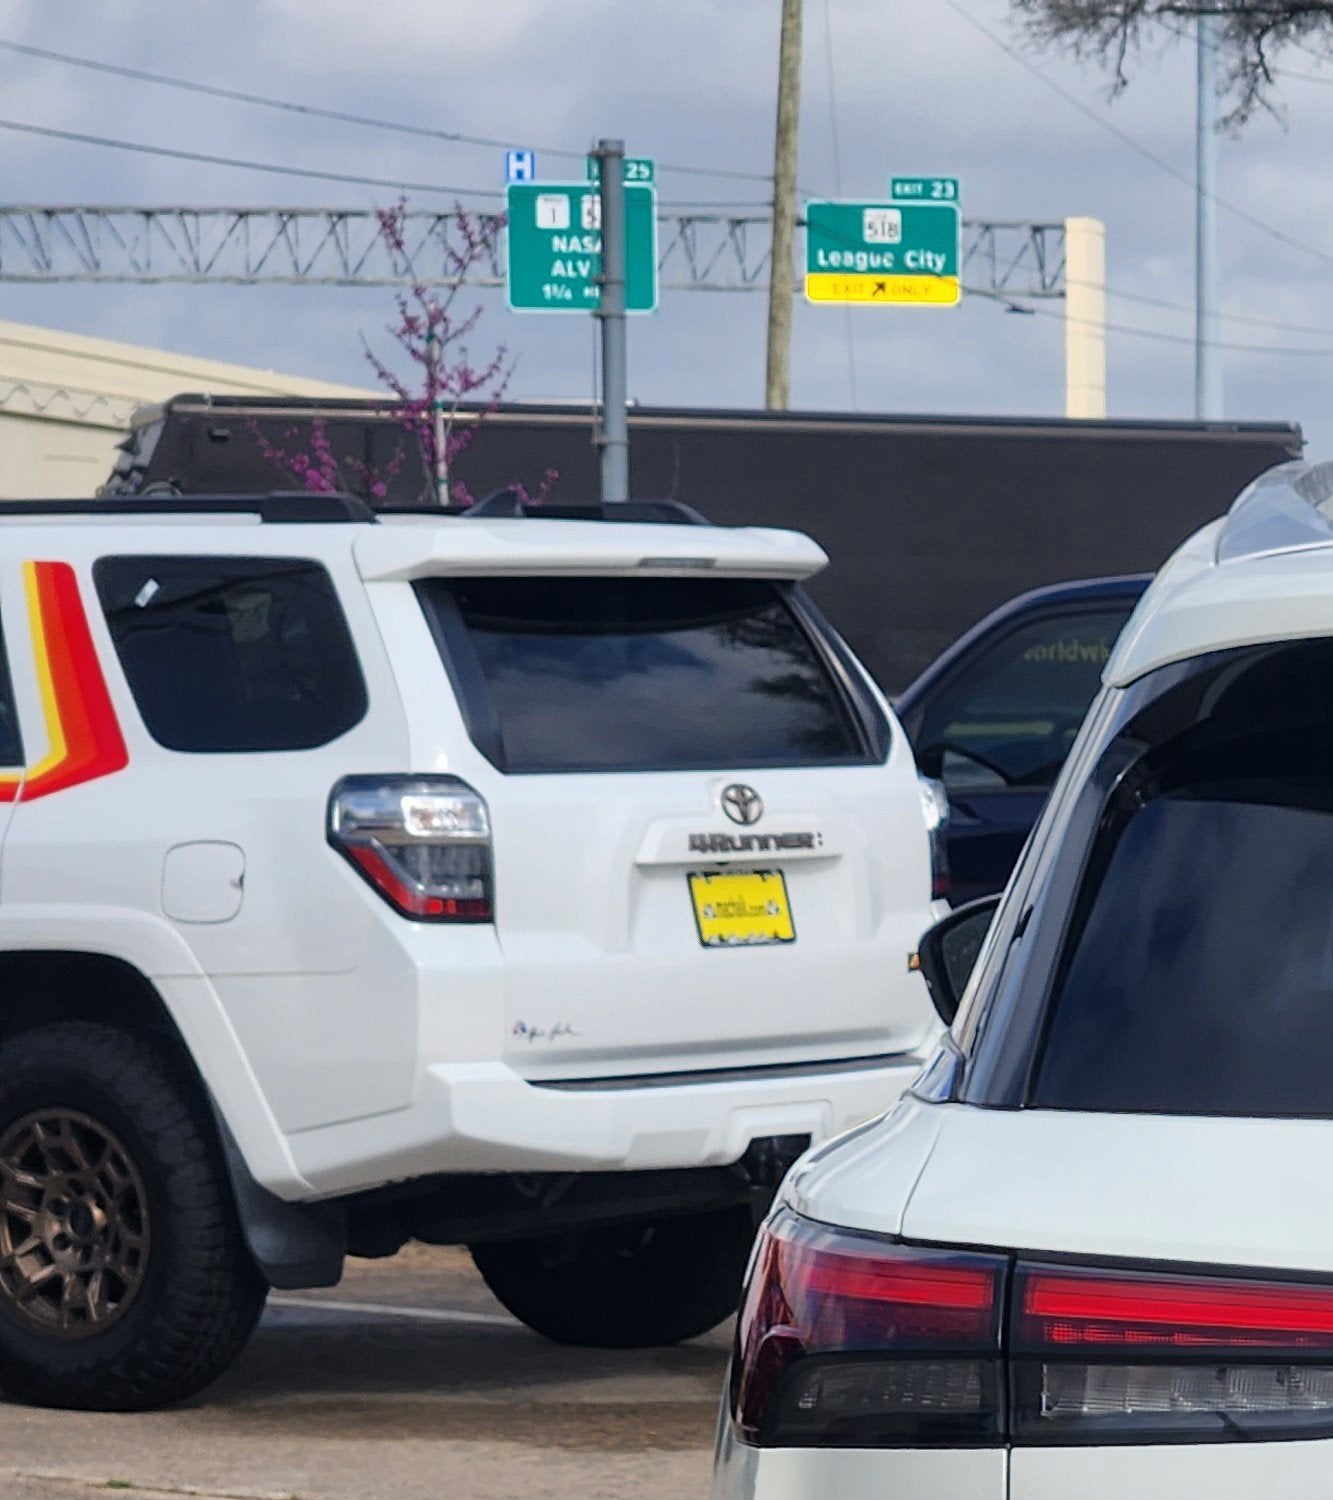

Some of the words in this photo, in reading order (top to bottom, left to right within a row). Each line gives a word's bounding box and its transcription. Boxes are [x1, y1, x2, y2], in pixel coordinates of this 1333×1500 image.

[626, 162, 651, 179] 25
[930, 181, 955, 199] 23
[866, 219, 899, 238] 518
[817, 248, 895, 272] League
[903, 248, 946, 273] City
